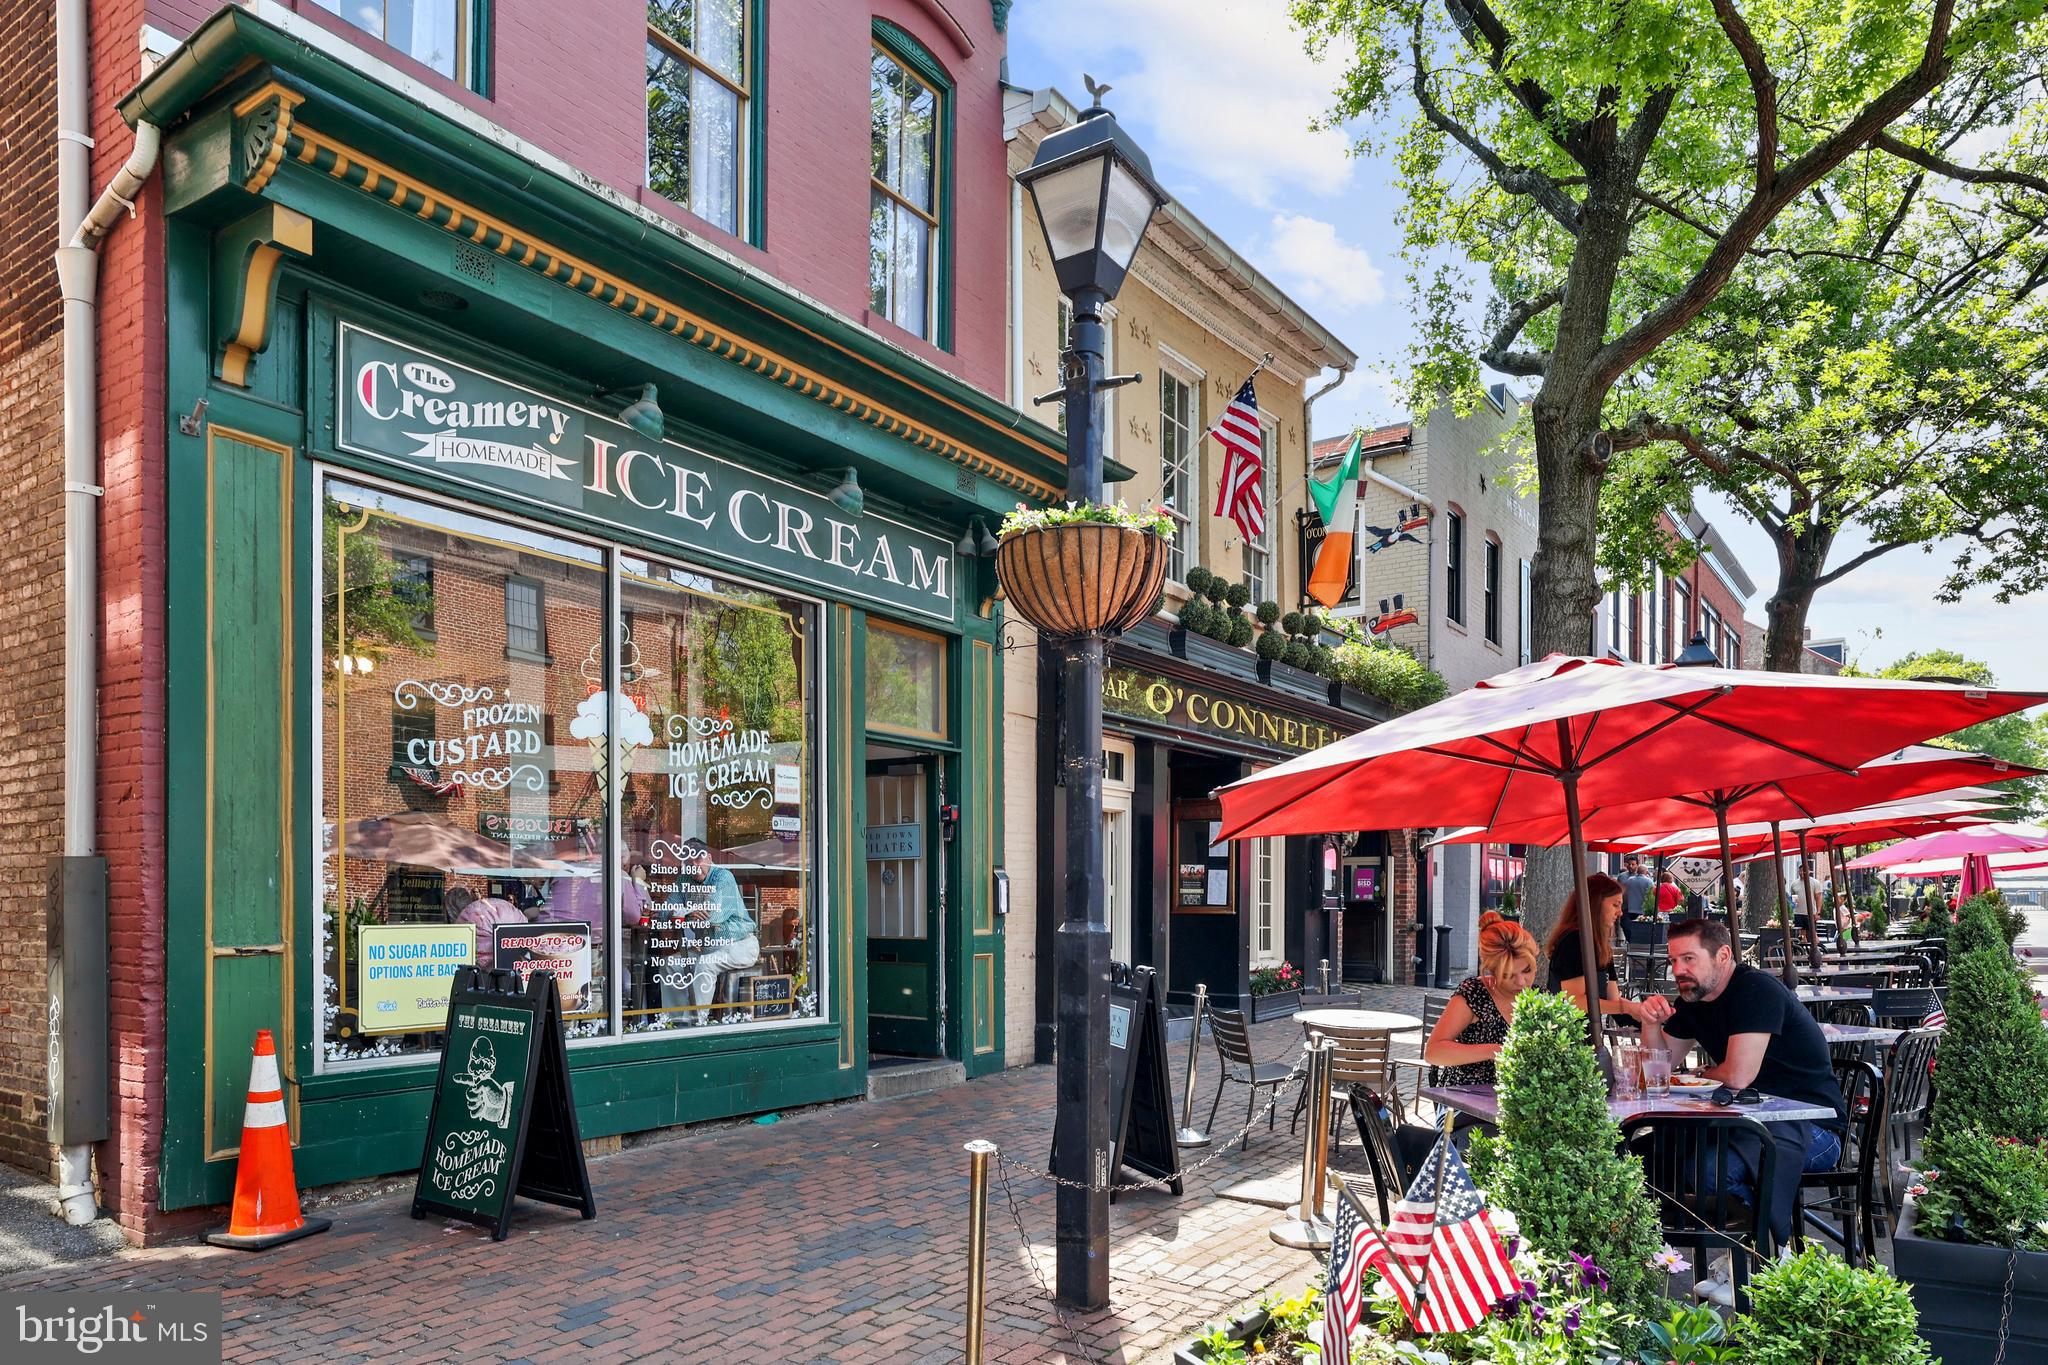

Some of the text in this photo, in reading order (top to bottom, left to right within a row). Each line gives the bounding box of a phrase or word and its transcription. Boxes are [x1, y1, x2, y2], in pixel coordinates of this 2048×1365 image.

[411, 366, 450, 388] The
[356, 361, 571, 444] Creamery
[441, 441, 547, 472] HOMEMADE
[583, 434, 949, 599] ICE CREAM
[463, 703, 540, 730] FROZEN
[407, 729, 540, 766] CUSTARD
[668, 729, 771, 767] HOMEMADE
[668, 758, 772, 798] ICE CREAM
[887, 831, 913, 839] TOWN
[650, 863, 702, 875] Since 1984
[650, 882, 717, 893] Fresh Flavors
[650, 900, 722, 912] Indoor Seating
[650, 919, 710, 930] Fast Service
[369, 943, 467, 960] NO SUGAR ADDED
[501, 936, 583, 948] READY-TO-GO
[650, 936, 735, 950] Dairy Free Sorbet
[513, 959, 572, 971] PACKAGED
[650, 954, 728, 968] No Sugar Added
[369, 965, 413, 980] OPTIONS
[415, 964, 435, 977] ARE
[459, 1014, 525, 1035] THE CREAMERY
[435, 1138, 507, 1171] HOMEMADE
[432, 1157, 501, 1191] ICE CREAM
